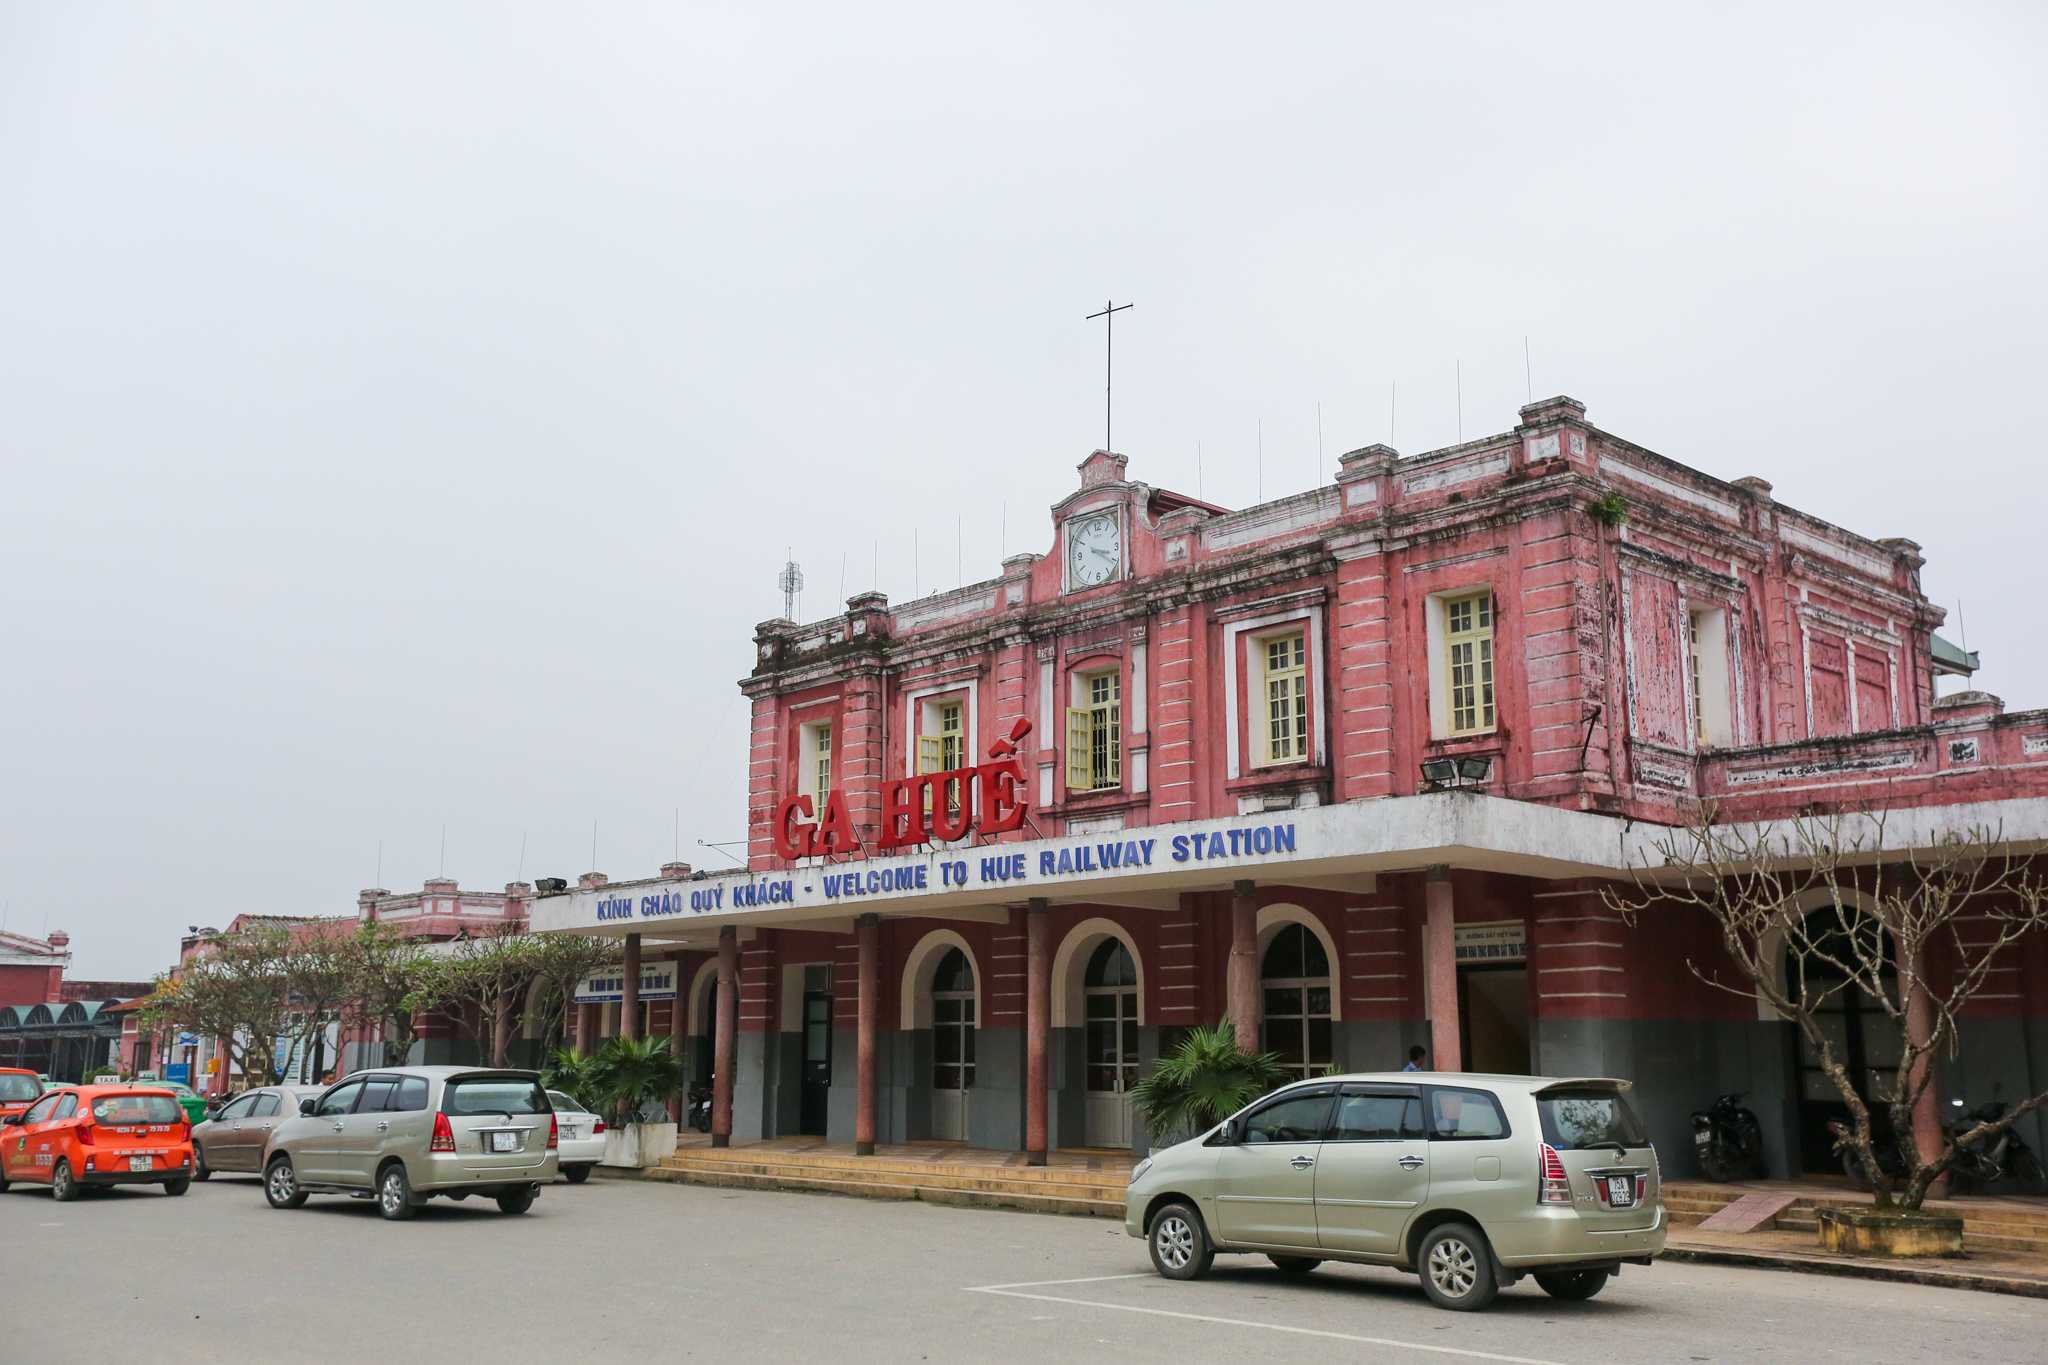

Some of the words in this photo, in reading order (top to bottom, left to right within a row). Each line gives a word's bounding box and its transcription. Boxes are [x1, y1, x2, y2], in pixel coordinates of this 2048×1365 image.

[1094, 522, 1101, 531] 12
[1077, 552, 1083, 561] 9
[1114, 543, 1119, 551] 3
[1095, 572, 1101, 580] 6
[774, 789, 860, 861] GA
[877, 717, 1032, 849] HUẾ
[641, 888, 682, 917] CHÀO
[733, 876, 793, 908] KHÁCH
[823, 864, 928, 898] WELCOME
[940, 861, 967, 886] TO
[981, 853, 1027, 882] HUE
[1040, 839, 1156, 875] RAILWAY
[1172, 824, 1296, 862] STATION
[498, 1133, 510, 1141] 75A
[1612, 1178, 1625, 1190] 75A
